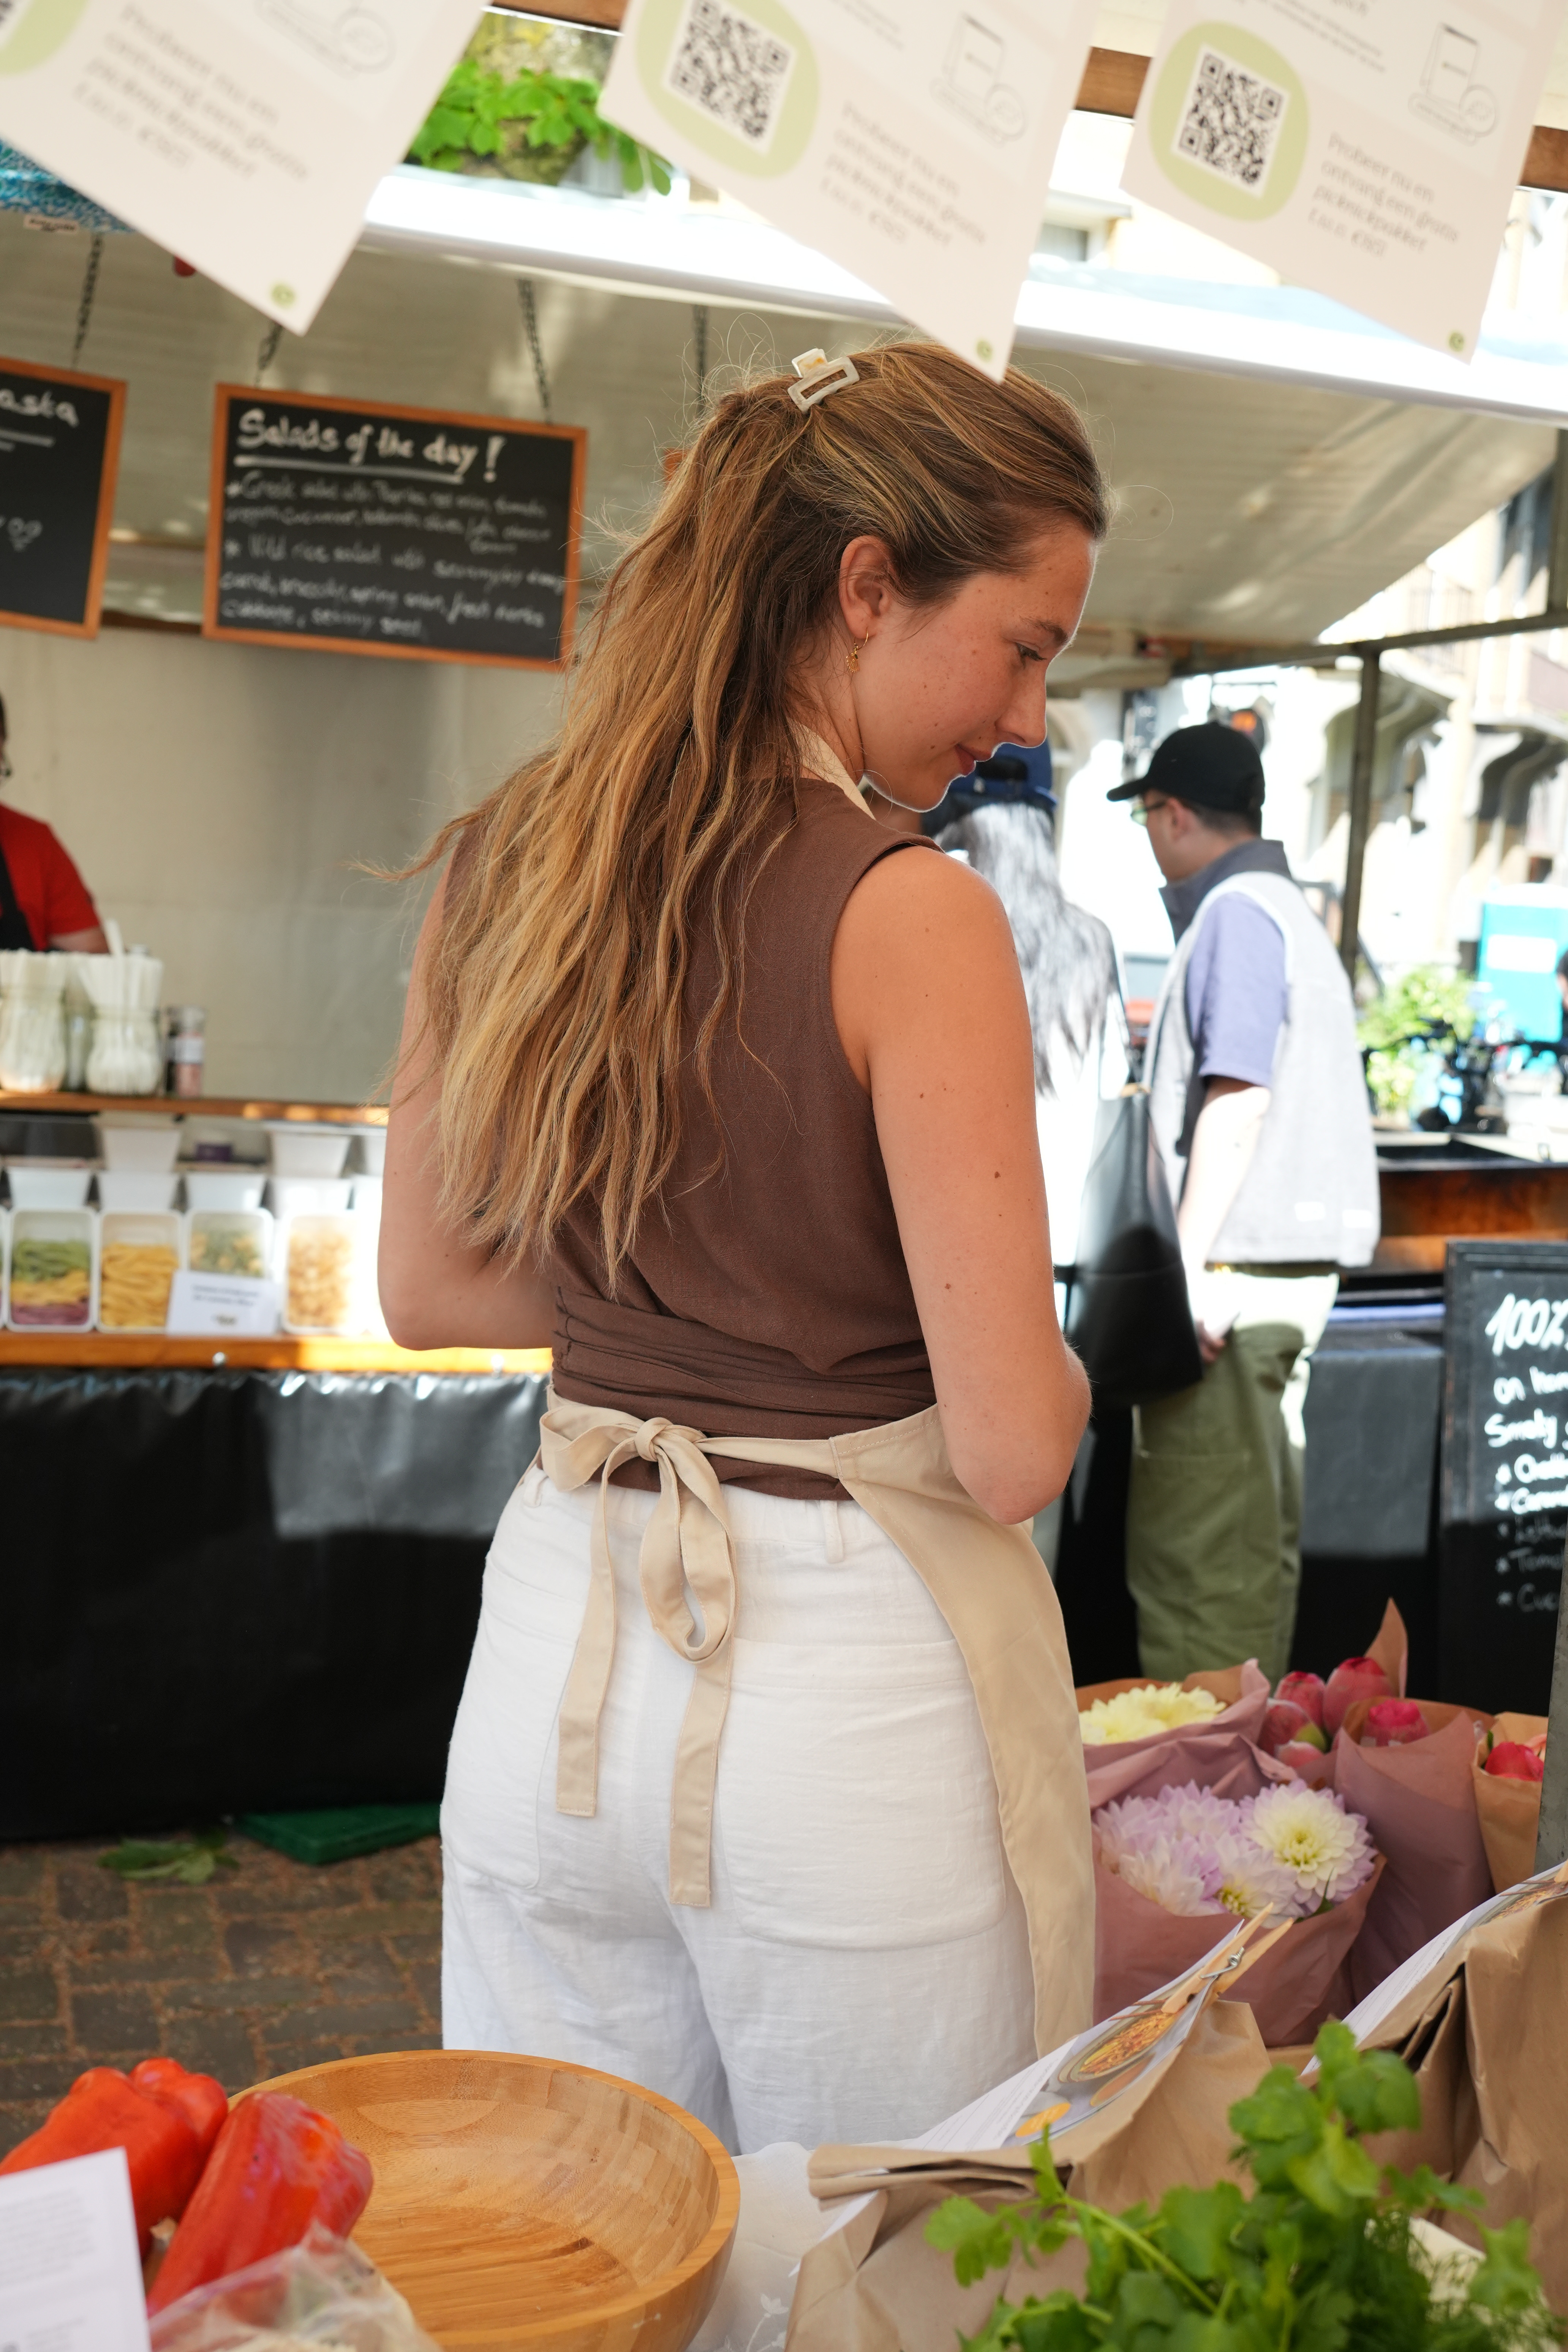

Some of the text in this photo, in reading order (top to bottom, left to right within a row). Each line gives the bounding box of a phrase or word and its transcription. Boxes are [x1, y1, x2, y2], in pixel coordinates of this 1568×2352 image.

[237, 408, 340, 452] Salads
[345, 423, 375, 466] of
[375, 426, 414, 458] the
